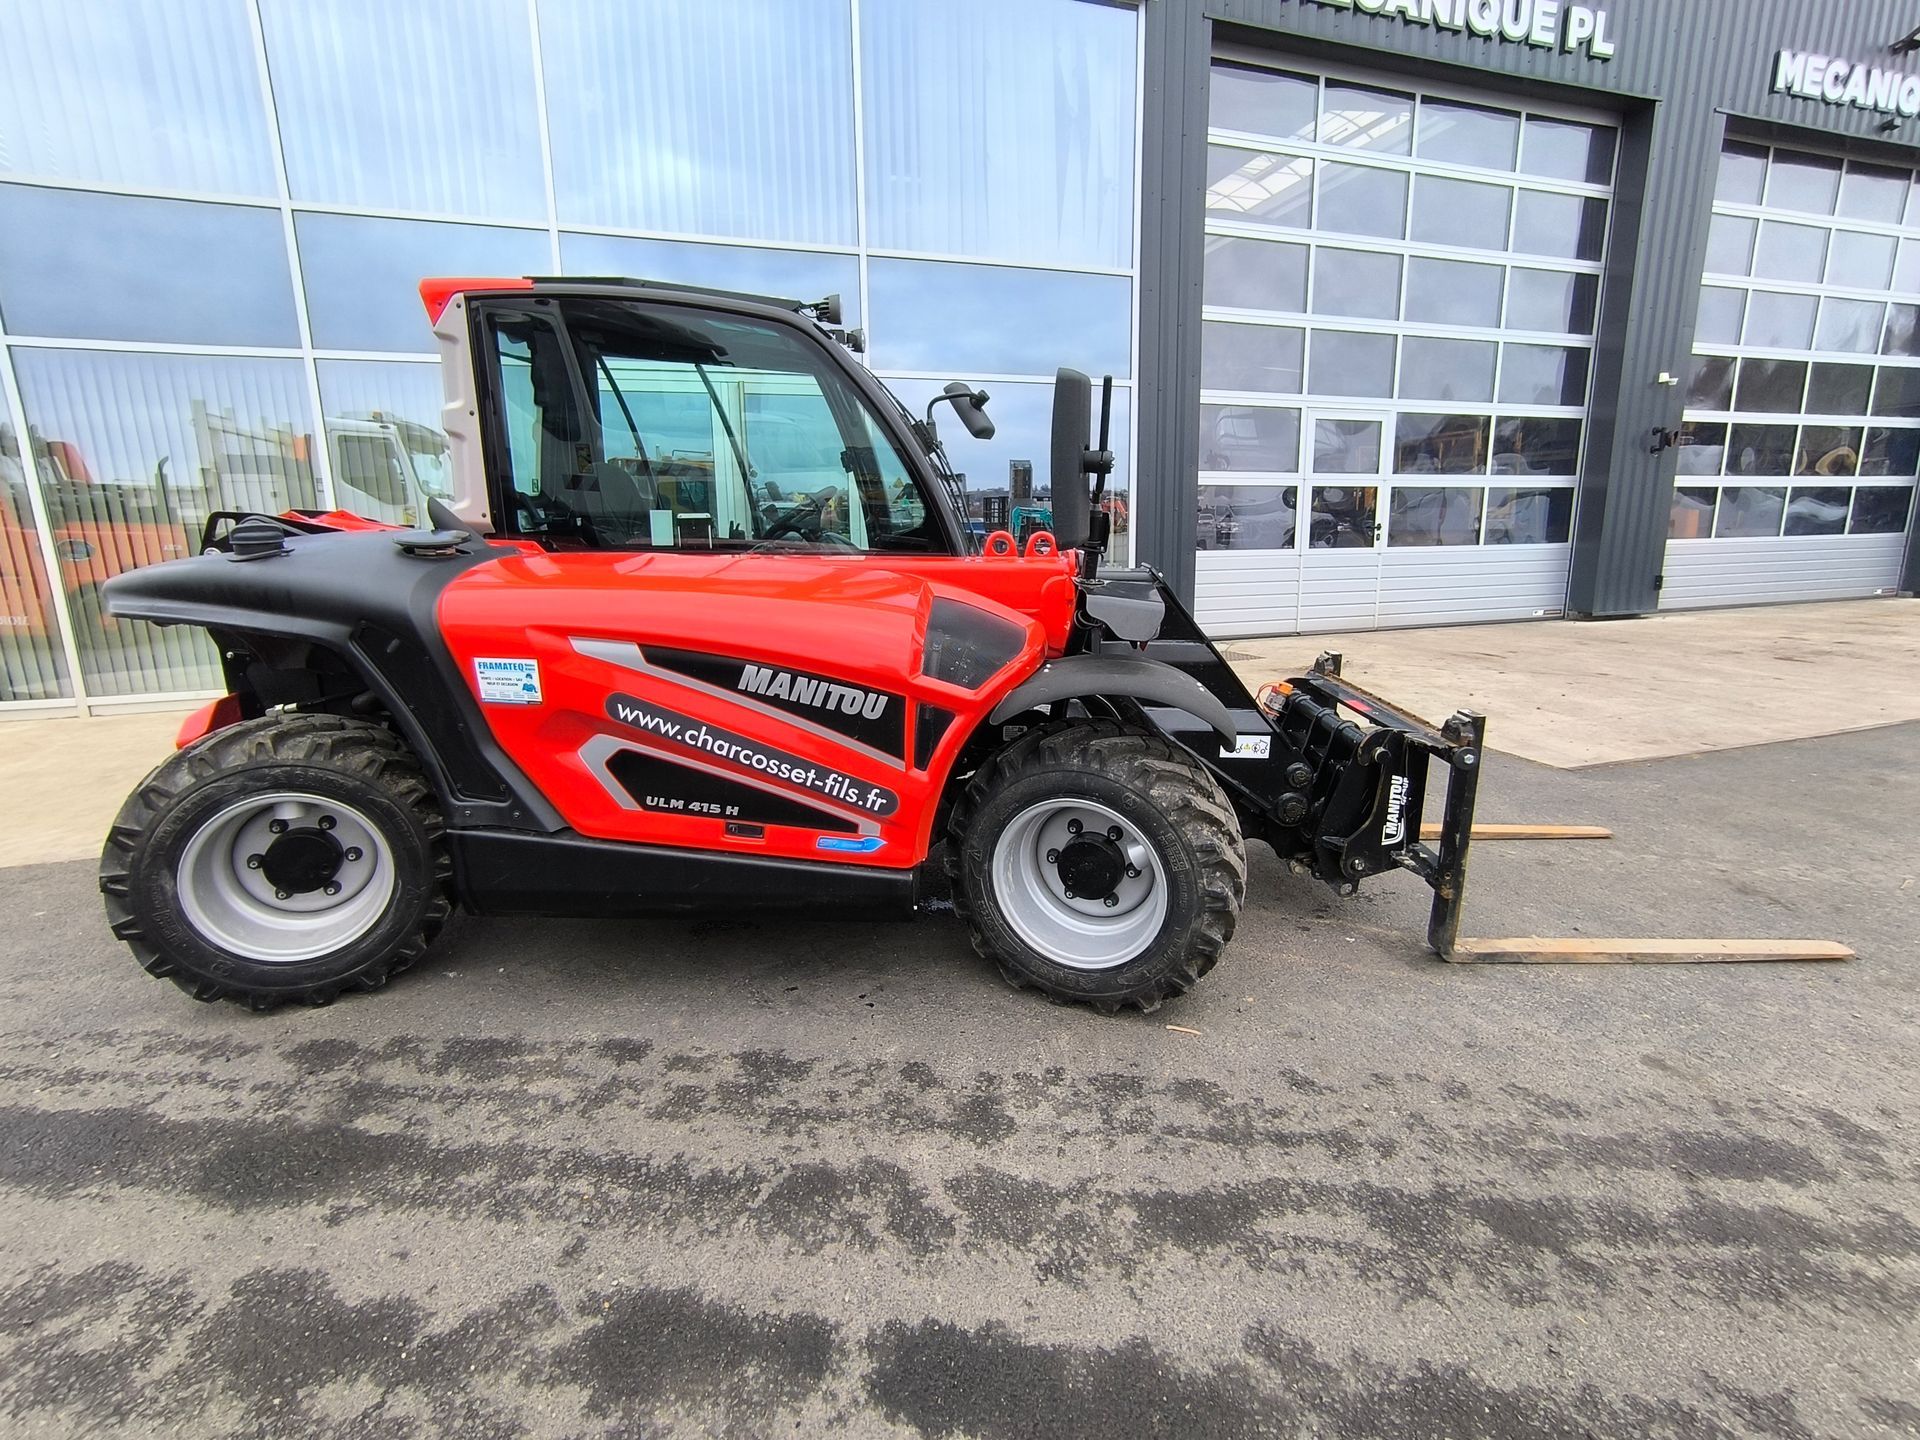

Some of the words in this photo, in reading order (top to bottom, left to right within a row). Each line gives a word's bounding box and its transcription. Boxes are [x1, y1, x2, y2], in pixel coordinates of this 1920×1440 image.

[1566, 5, 1615, 59] PL
[1774, 49, 1920, 117] MECANIQ
[478, 662, 525, 672] FRAMATEQ
[737, 664, 889, 720] MANITOU
[617, 703, 887, 811] www.charcosset-fils.fr
[646, 796, 684, 809] ULM
[688, 801, 721, 813] 415
[725, 805, 739, 816] H
[1385, 774, 1403, 835] MANITOU
